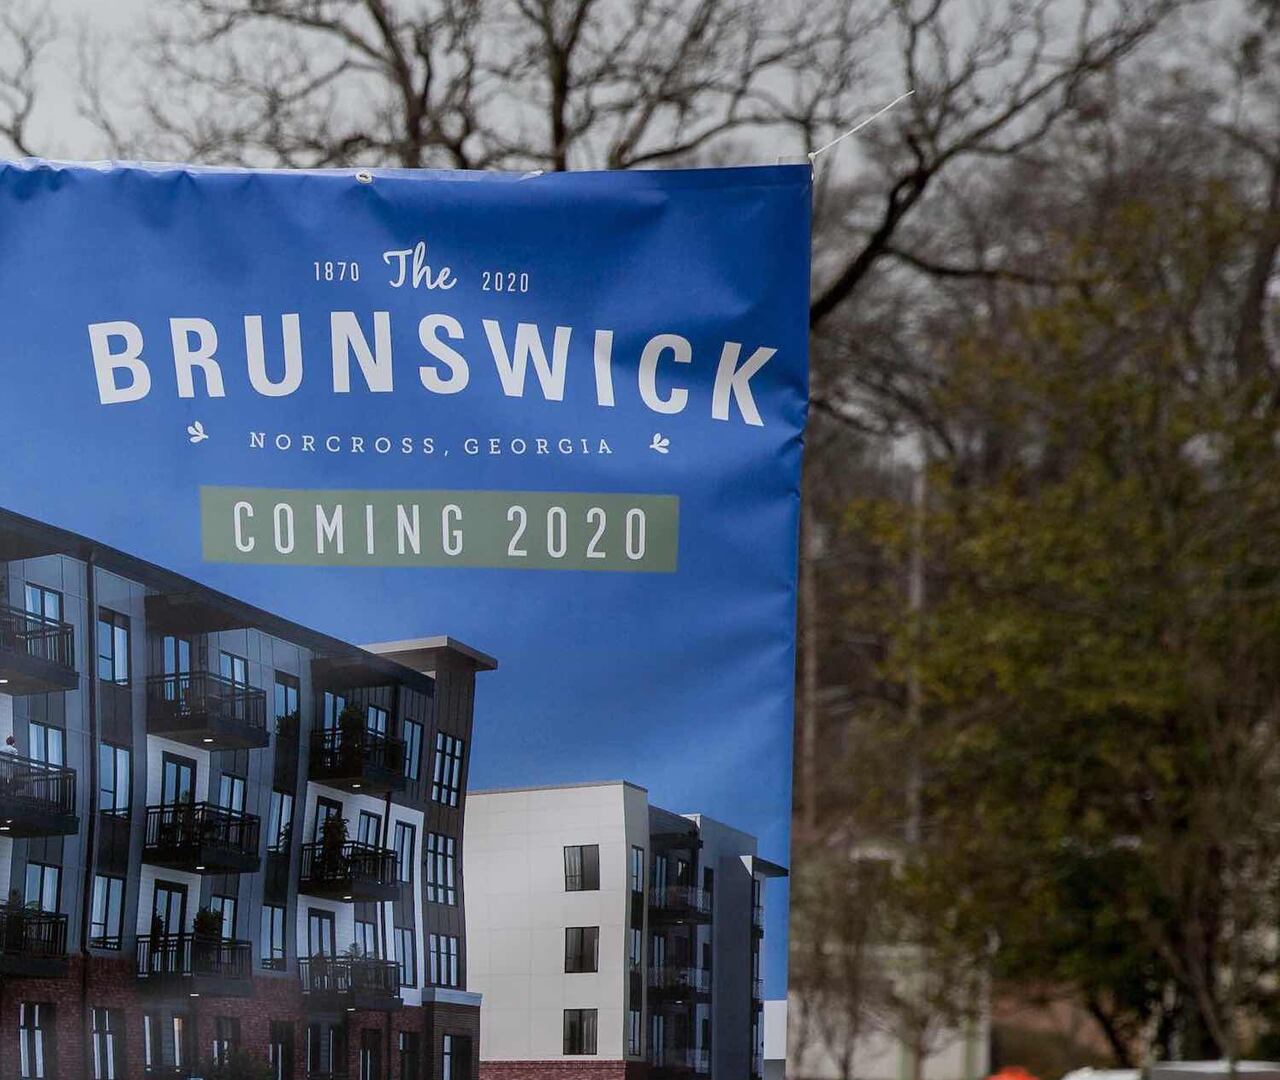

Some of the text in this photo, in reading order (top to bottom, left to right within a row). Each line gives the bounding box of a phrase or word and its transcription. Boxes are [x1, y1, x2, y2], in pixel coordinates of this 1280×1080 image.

[313, 240, 530, 293] 1870 The 2020
[88, 311, 779, 427] BRUNSWICK
[249, 431, 613, 456] NORCROSS, GEORGIA
[233, 501, 647, 561] COMING 2020
